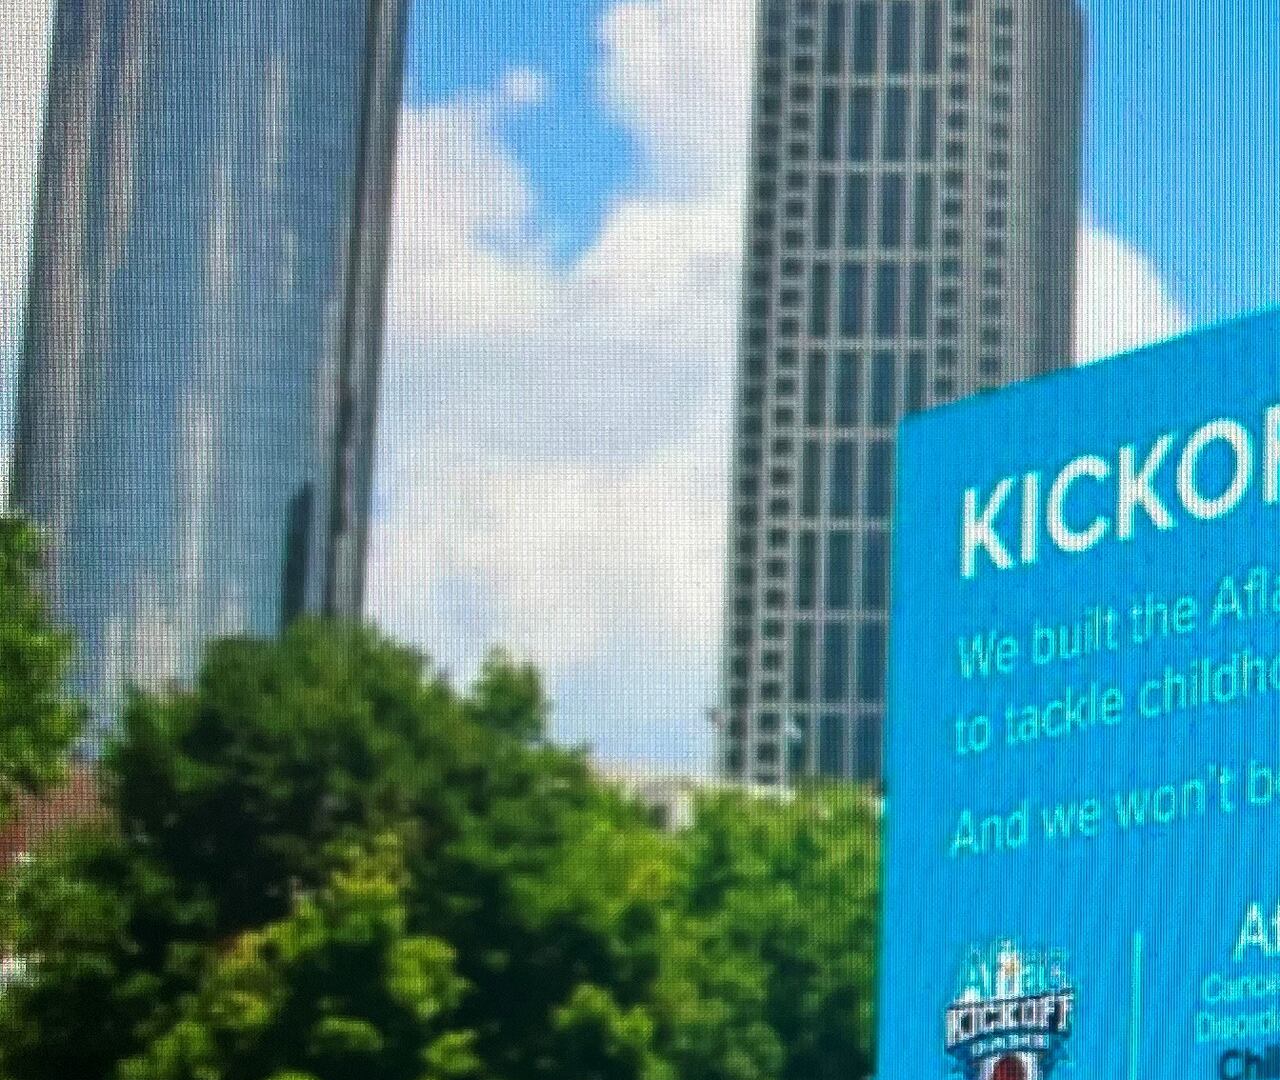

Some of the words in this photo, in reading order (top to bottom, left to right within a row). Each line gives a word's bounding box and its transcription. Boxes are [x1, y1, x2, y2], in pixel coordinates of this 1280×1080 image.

[957, 632, 1017, 680] We
[1031, 606, 1119, 666] built
[1129, 594, 1197, 646] the
[953, 711, 990, 755] to
[1004, 685, 1123, 747] tackle
[949, 804, 1029, 857] And
[1041, 800, 1102, 843] we
[1116, 766, 1231, 832] won't
[946, 994, 1075, 1047] KICKOFF
